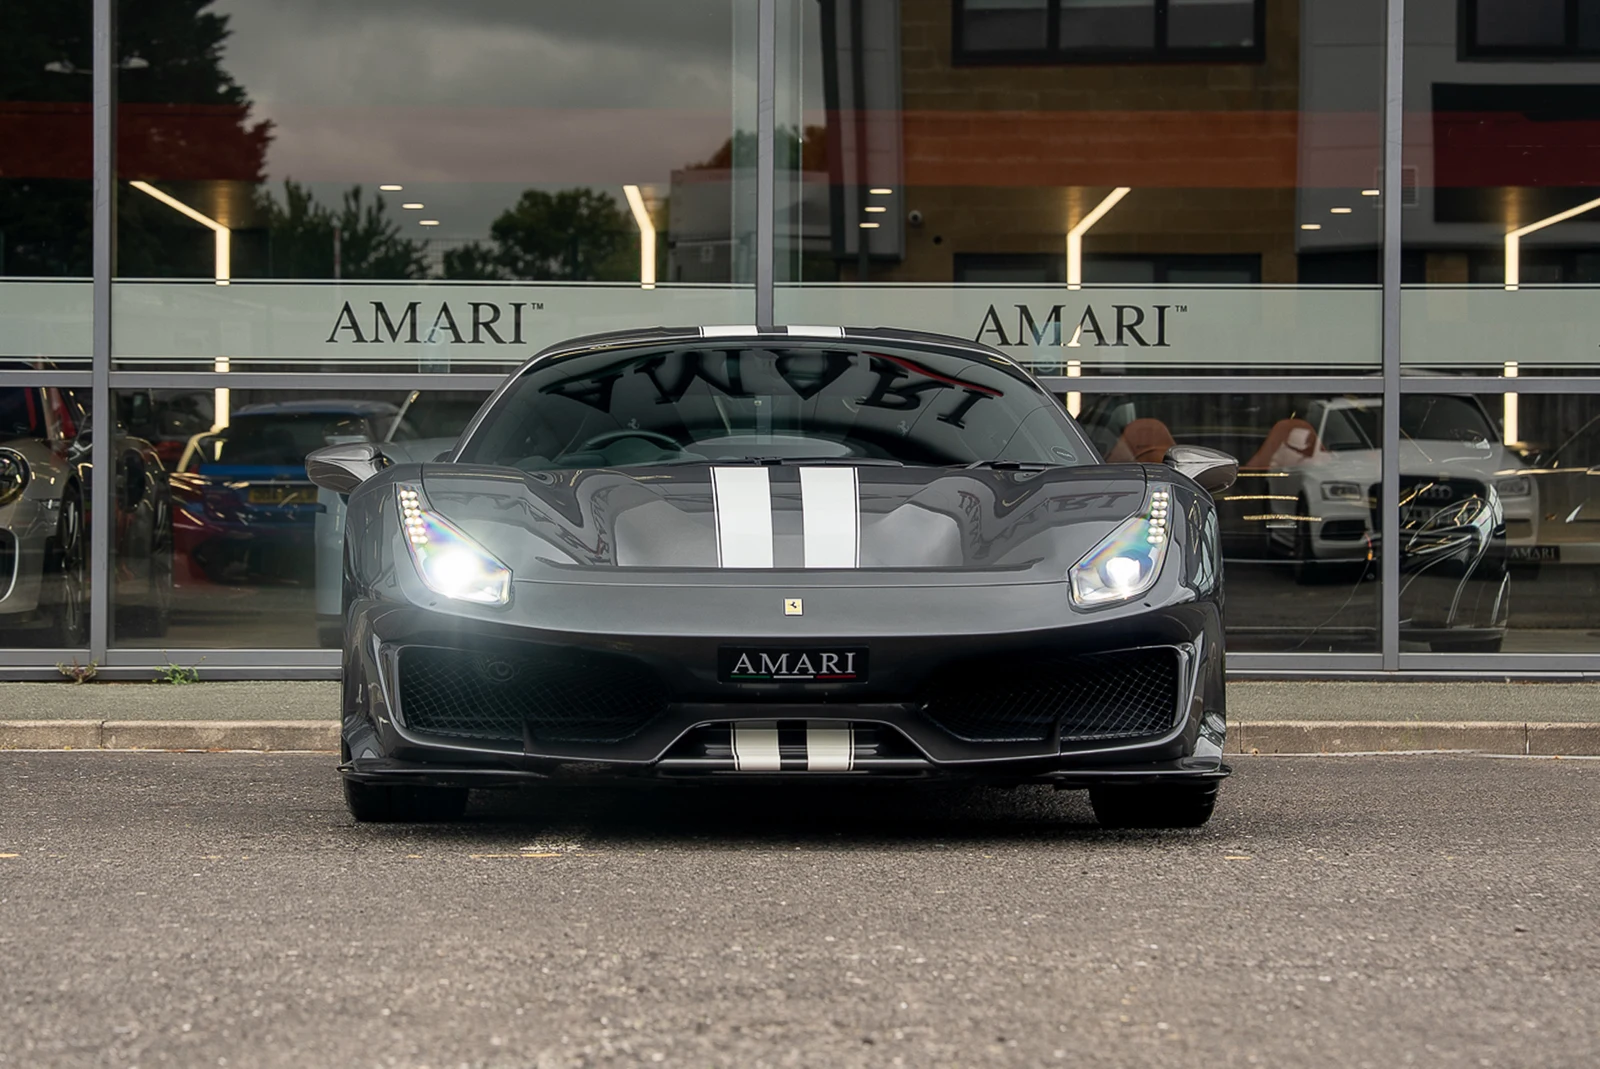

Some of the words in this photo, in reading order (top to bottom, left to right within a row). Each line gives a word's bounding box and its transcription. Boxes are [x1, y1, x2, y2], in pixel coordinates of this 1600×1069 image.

[325, 301, 527, 344] AMARI
[974, 304, 1171, 347] AMARI
[731, 652, 856, 674] AMARI
